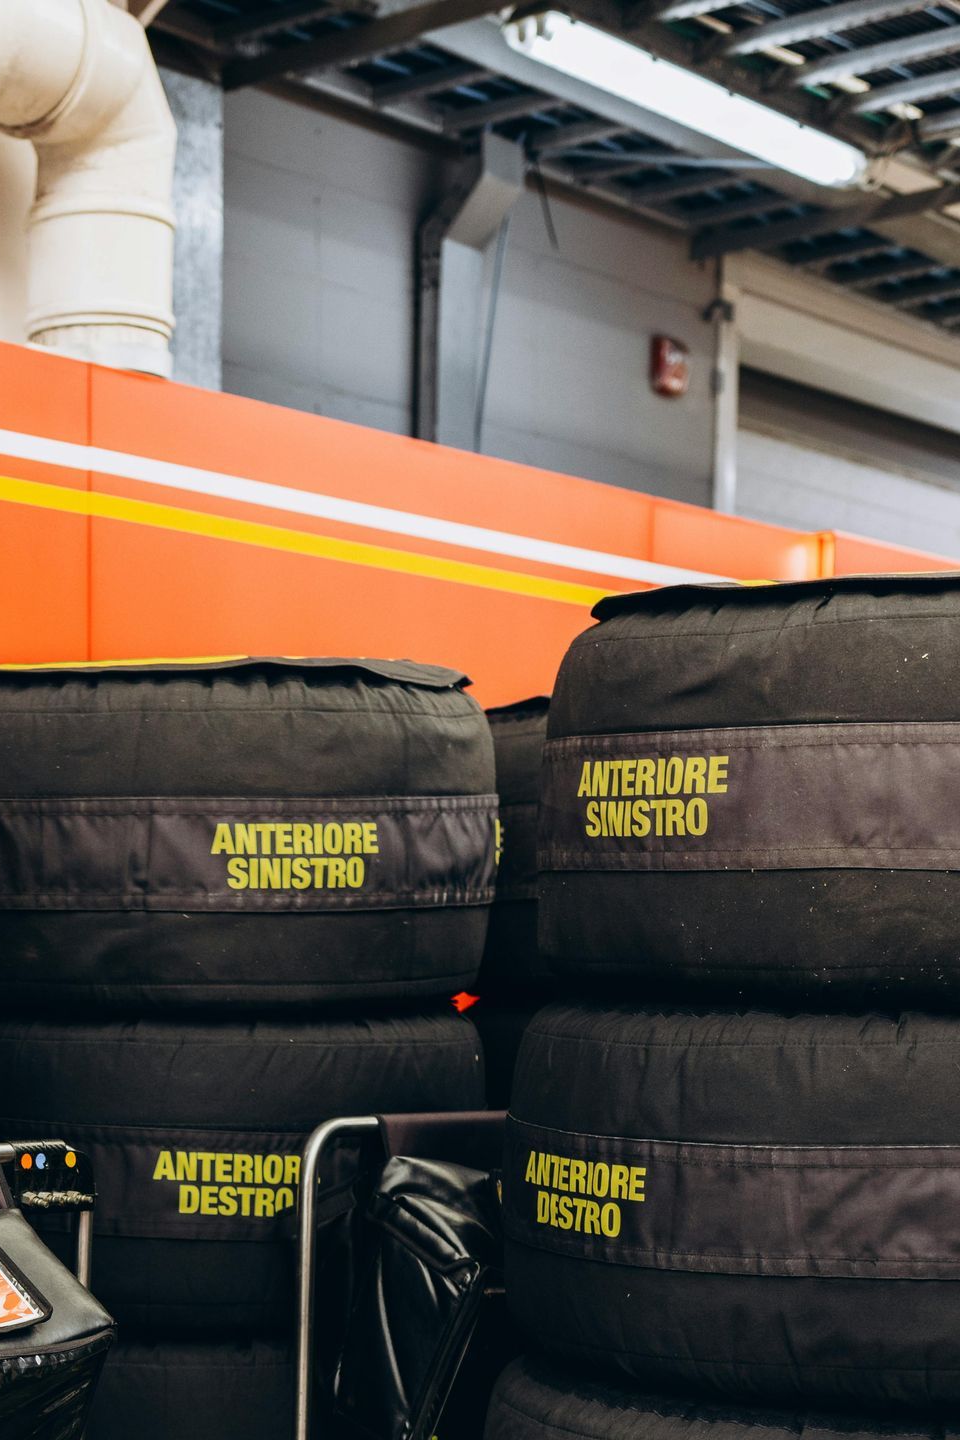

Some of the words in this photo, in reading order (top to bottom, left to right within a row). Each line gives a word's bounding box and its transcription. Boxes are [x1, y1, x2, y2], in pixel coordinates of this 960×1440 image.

[577, 755, 729, 798] ANTERIORE
[586, 798, 708, 838] SINISTRO
[211, 822, 379, 855] ANTERIORE
[227, 856, 365, 889] SINISTRO
[153, 1151, 320, 1184] ANTERIOR
[525, 1151, 646, 1202] ANTERIORE
[179, 1185, 294, 1217] DESTRO
[537, 1191, 621, 1238] DESTRO
